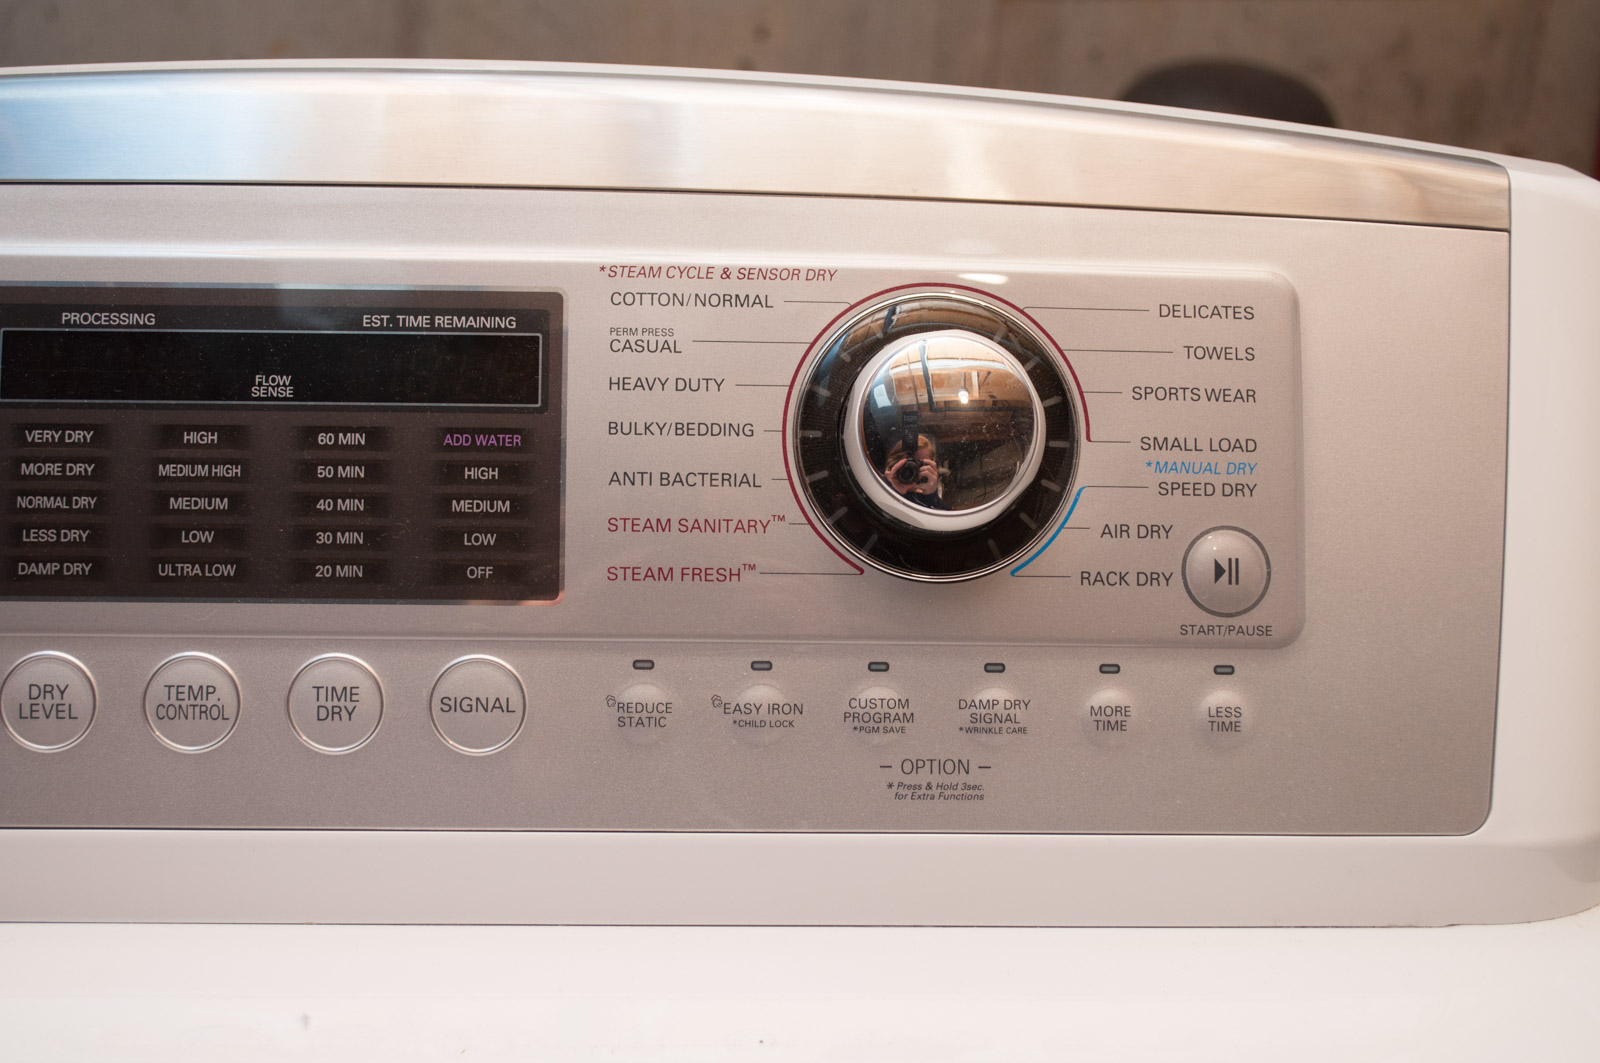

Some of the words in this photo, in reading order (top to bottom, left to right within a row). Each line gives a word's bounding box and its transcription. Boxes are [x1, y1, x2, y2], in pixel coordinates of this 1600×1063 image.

[666, 266, 715, 280] CYCLE
[720, 268, 732, 280] &
[736, 268, 800, 281] SENSOR
[805, 269, 838, 281] DRY
[610, 292, 774, 308] COTTON/NORMAL
[1159, 304, 1255, 320] DELICATES
[61, 312, 156, 326] PROCESSING
[362, 314, 393, 328] EST.
[397, 315, 430, 328] TIME
[434, 315, 517, 329] REMAINING
[610, 328, 639, 336] PERM
[642, 328, 674, 337] PRESS
[609, 339, 682, 353] CASUAL
[1183, 346, 1256, 361] TOWELS
[255, 375, 291, 386] FLOW
[608, 377, 669, 391] HEAVY
[675, 378, 724, 392] DUTY
[251, 386, 294, 398] SENSE
[1132, 386, 1201, 401] SPORTS
[1205, 388, 1257, 403] WEAR
[608, 421, 754, 437] BULKY/BEDDING
[25, 430, 62, 443] VERY
[64, 430, 94, 443] DRY
[183, 431, 218, 444] HIGH
[317, 432, 334, 446] 60
[338, 432, 366, 446] MIN
[443, 434, 470, 447] ADD
[473, 434, 522, 447] WATER
[1140, 436, 1203, 451] SMALL
[1209, 438, 1257, 453] LOAD
[21, 463, 62, 476] MORE
[66, 463, 95, 476] DRY
[158, 464, 208, 477] MEDIUM
[211, 464, 241, 477] HIGH
[317, 465, 334, 479] 50
[337, 465, 365, 479] MIN
[464, 467, 499, 480] HIGH
[1226, 462, 1257, 475] DRY
[608, 471, 652, 487] ANTI
[660, 472, 762, 487] BACTERIAL
[1158, 482, 1216, 497] SPEED
[1222, 483, 1257, 497] DRY
[17, 496, 68, 509] NORMAL
[71, 496, 97, 509] DRY
[169, 497, 228, 511] MEDIUM
[316, 498, 334, 512] 40
[337, 498, 365, 512] MIN
[451, 499, 510, 513] MEDIUM
[607, 517, 672, 533] STEAM
[1100, 524, 1131, 539] AIR
[1137, 525, 1173, 539] DRY
[22, 529, 57, 542] LESS
[59, 529, 89, 542] DRY
[181, 530, 214, 543] LOW
[315, 531, 333, 545] 30
[336, 531, 364, 545] MIN
[464, 533, 496, 546] LOW
[18, 562, 60, 575] DAMP
[63, 563, 92, 575] DRY
[158, 564, 202, 576] ULTRA
[205, 564, 236, 576] LOW
[315, 565, 333, 578] 20
[335, 565, 363, 578] MIN
[466, 566, 493, 579] OFF
[607, 566, 674, 582] STEAM
[1080, 571, 1130, 586] RACK
[1136, 572, 1173, 586] DRY
[1180, 625, 1273, 637] START/PAUSE
[28, 683, 69, 701] DRY
[164, 685, 220, 702] TEMP.
[312, 686, 360, 703] TIME
[439, 696, 516, 714] SIGNAL
[617, 702, 673, 714] REDUCE
[723, 703, 763, 715] EASY
[768, 703, 803, 715] IRON
[848, 698, 909, 710] CUSTOM
[958, 699, 1000, 711] DAMP
[1004, 699, 1031, 711] DRY
[18, 703, 78, 721] LEVEL
[156, 703, 230, 721] CONTROL
[315, 704, 356, 722] DRY
[843, 712, 914, 724] PROGRAM
[970, 713, 1020, 724] SIGNAL
[1089, 706, 1131, 718] MORE
[1208, 707, 1242, 718] LESS
[617, 716, 667, 728] STATIC
[769, 720, 794, 728] LOCK
[1093, 720, 1127, 732] TIME
[1208, 721, 1241, 732] TIME
[883, 726, 906, 734] SAVE
[901, 759, 970, 775] OPTION
[897, 782, 923, 791] Press
[925, 782, 933, 791] &
[936, 782, 958, 791] Hold
[960, 782, 985, 791] 3sec.
[894, 792, 909, 801] for
[911, 792, 935, 801] Extra
[937, 792, 984, 802] Functions
